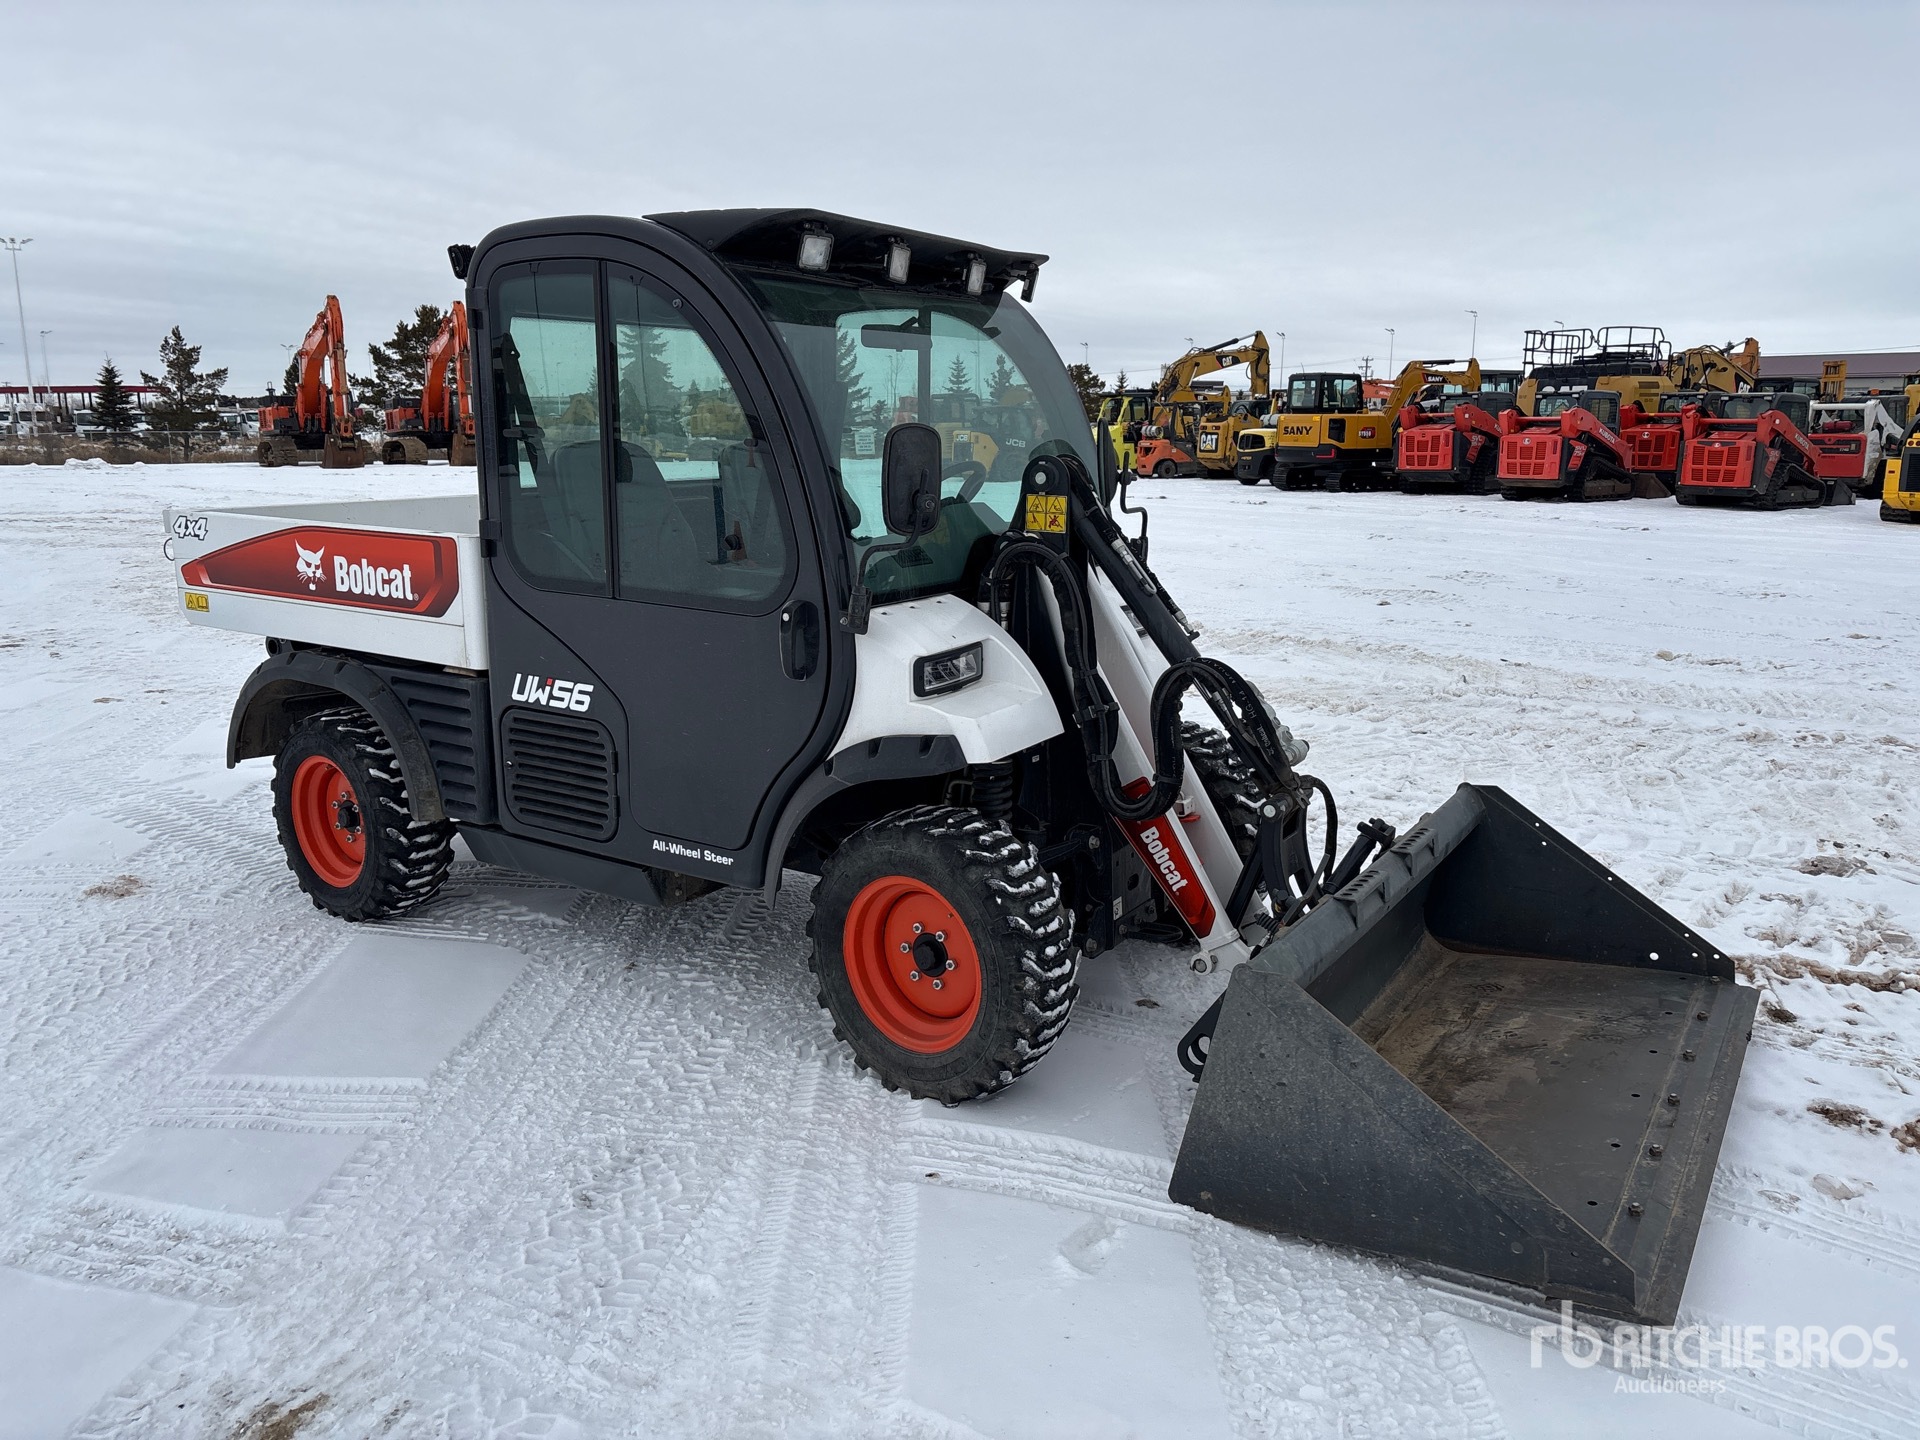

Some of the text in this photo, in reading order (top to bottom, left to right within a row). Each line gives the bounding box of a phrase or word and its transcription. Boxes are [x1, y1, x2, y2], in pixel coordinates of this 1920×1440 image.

[1222, 355, 1233, 367] CAT
[1283, 426, 1313, 436] SANY
[1599, 427, 1616, 444] KUBOTA
[1005, 438, 1026, 448] JCB
[1200, 433, 1218, 451] CAT
[1794, 433, 1809, 450] KUBOTA
[173, 515, 208, 540] 4x4
[333, 555, 414, 601] Bobcat
[511, 673, 595, 712] UW56
[652, 839, 734, 866] All-Wheel Steer
[1140, 826, 1188, 891] Bobcat
